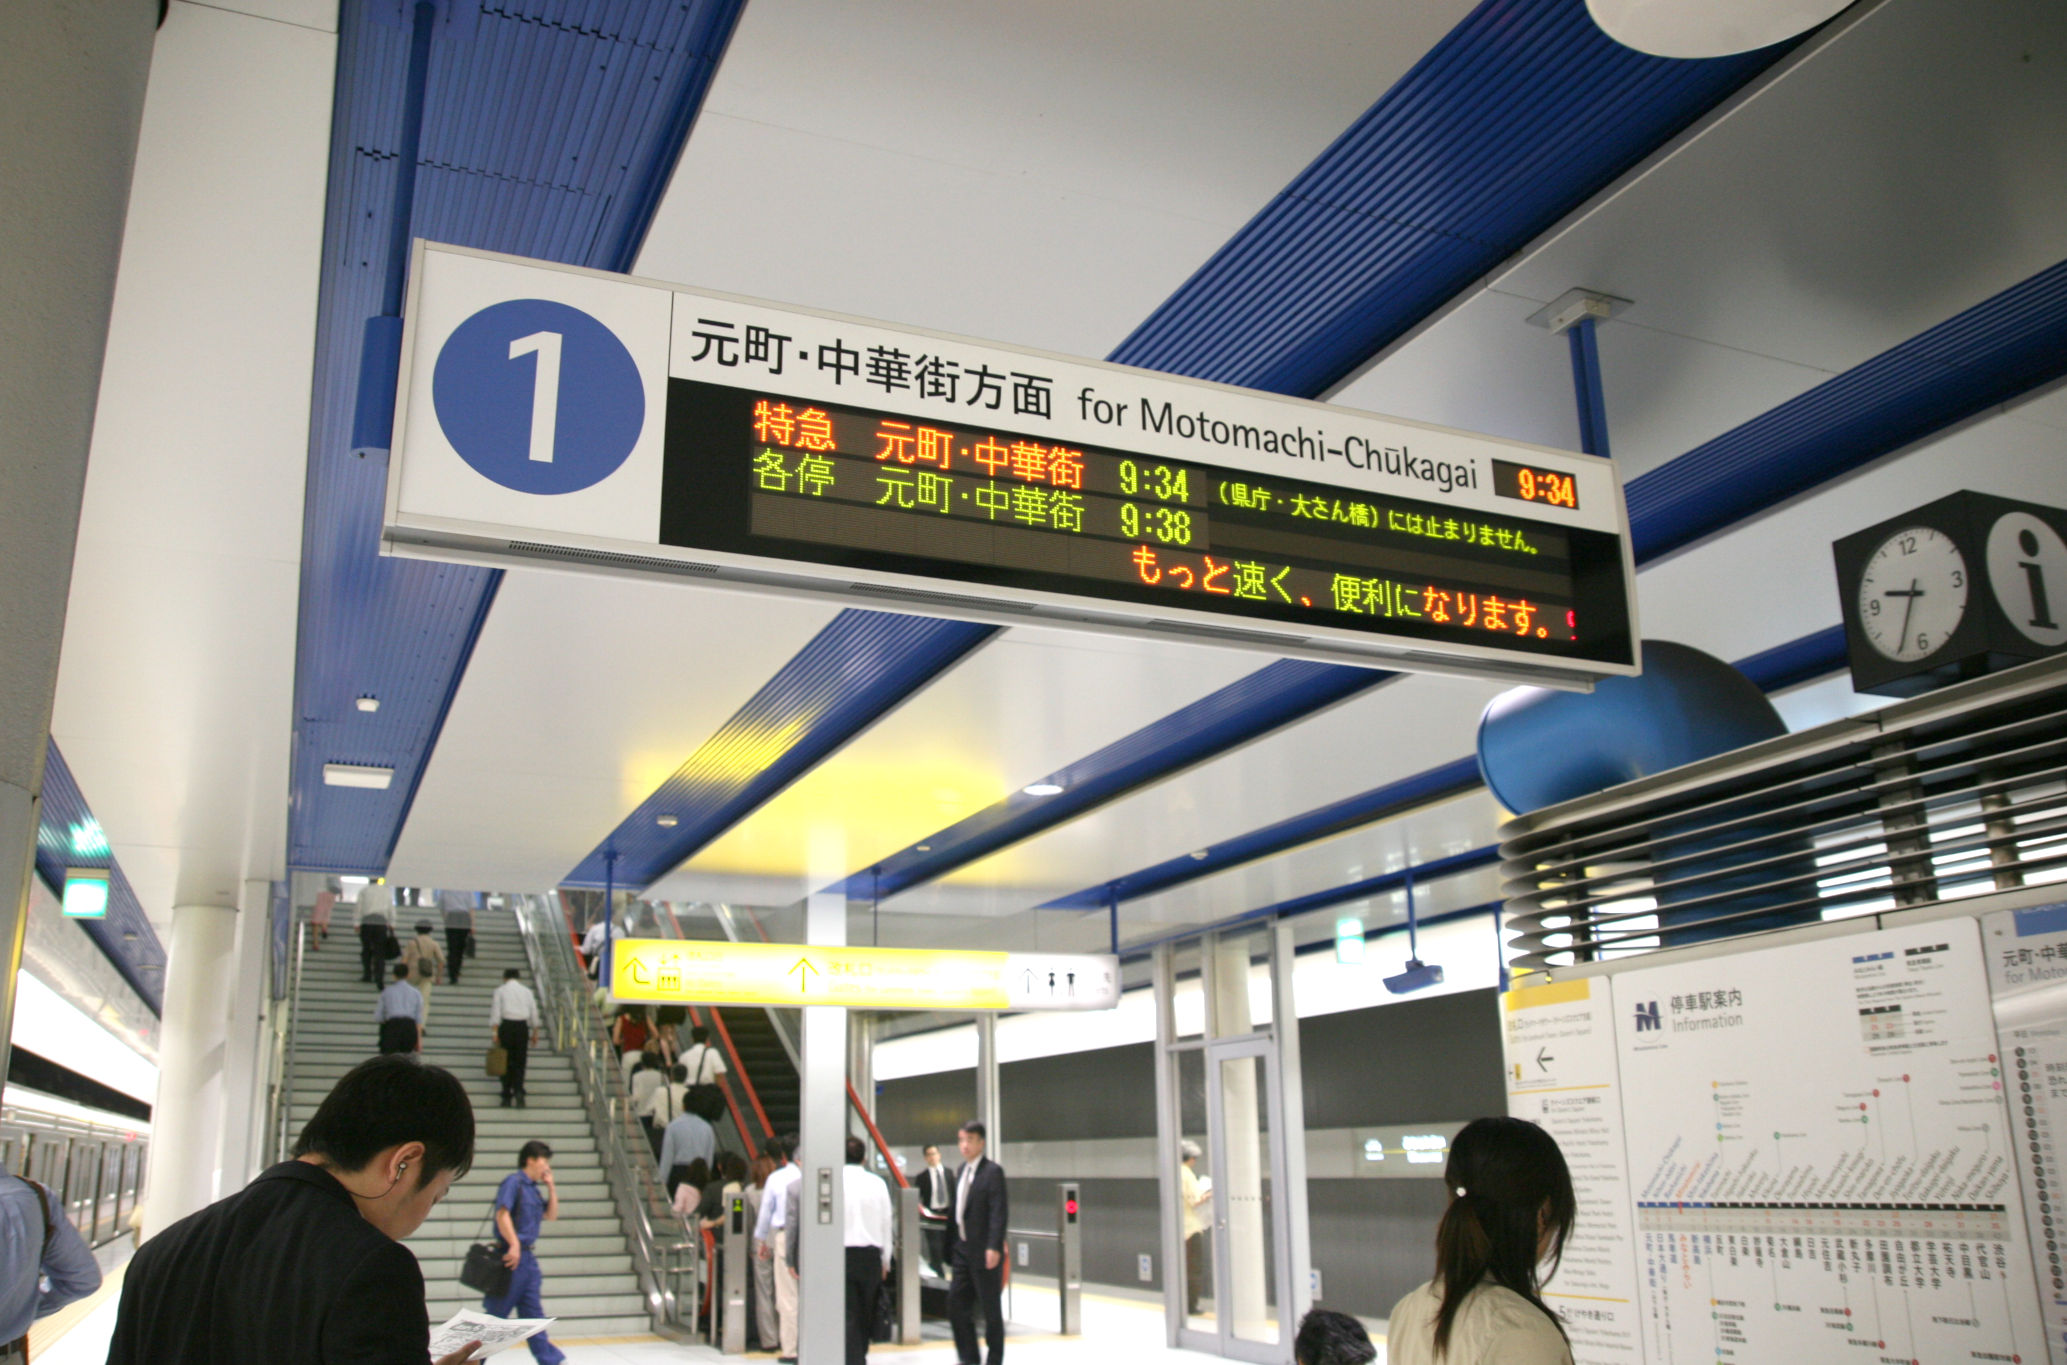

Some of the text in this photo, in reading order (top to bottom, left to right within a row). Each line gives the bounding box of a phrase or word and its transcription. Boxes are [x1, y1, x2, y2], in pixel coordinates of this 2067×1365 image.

[508, 330, 563, 463] 1
[690, 317, 1478, 493] 元町・中華街方面 for Motomachi-Chūkagai
[753, 399, 1190, 503] 特急 元町・中華街 9:34
[752, 446, 1192, 546] 各停 元町・中華街 9:38
[1517, 467, 1576, 509] 9:34
[1899, 536, 1917, 556] 12
[1951, 570, 1964, 588] 3
[1869, 599, 1881, 616] 9
[1916, 632, 1929, 650] 6
[2029, 966, 2067, 981] Moto
[1672, 1012, 1744, 1033] Information
